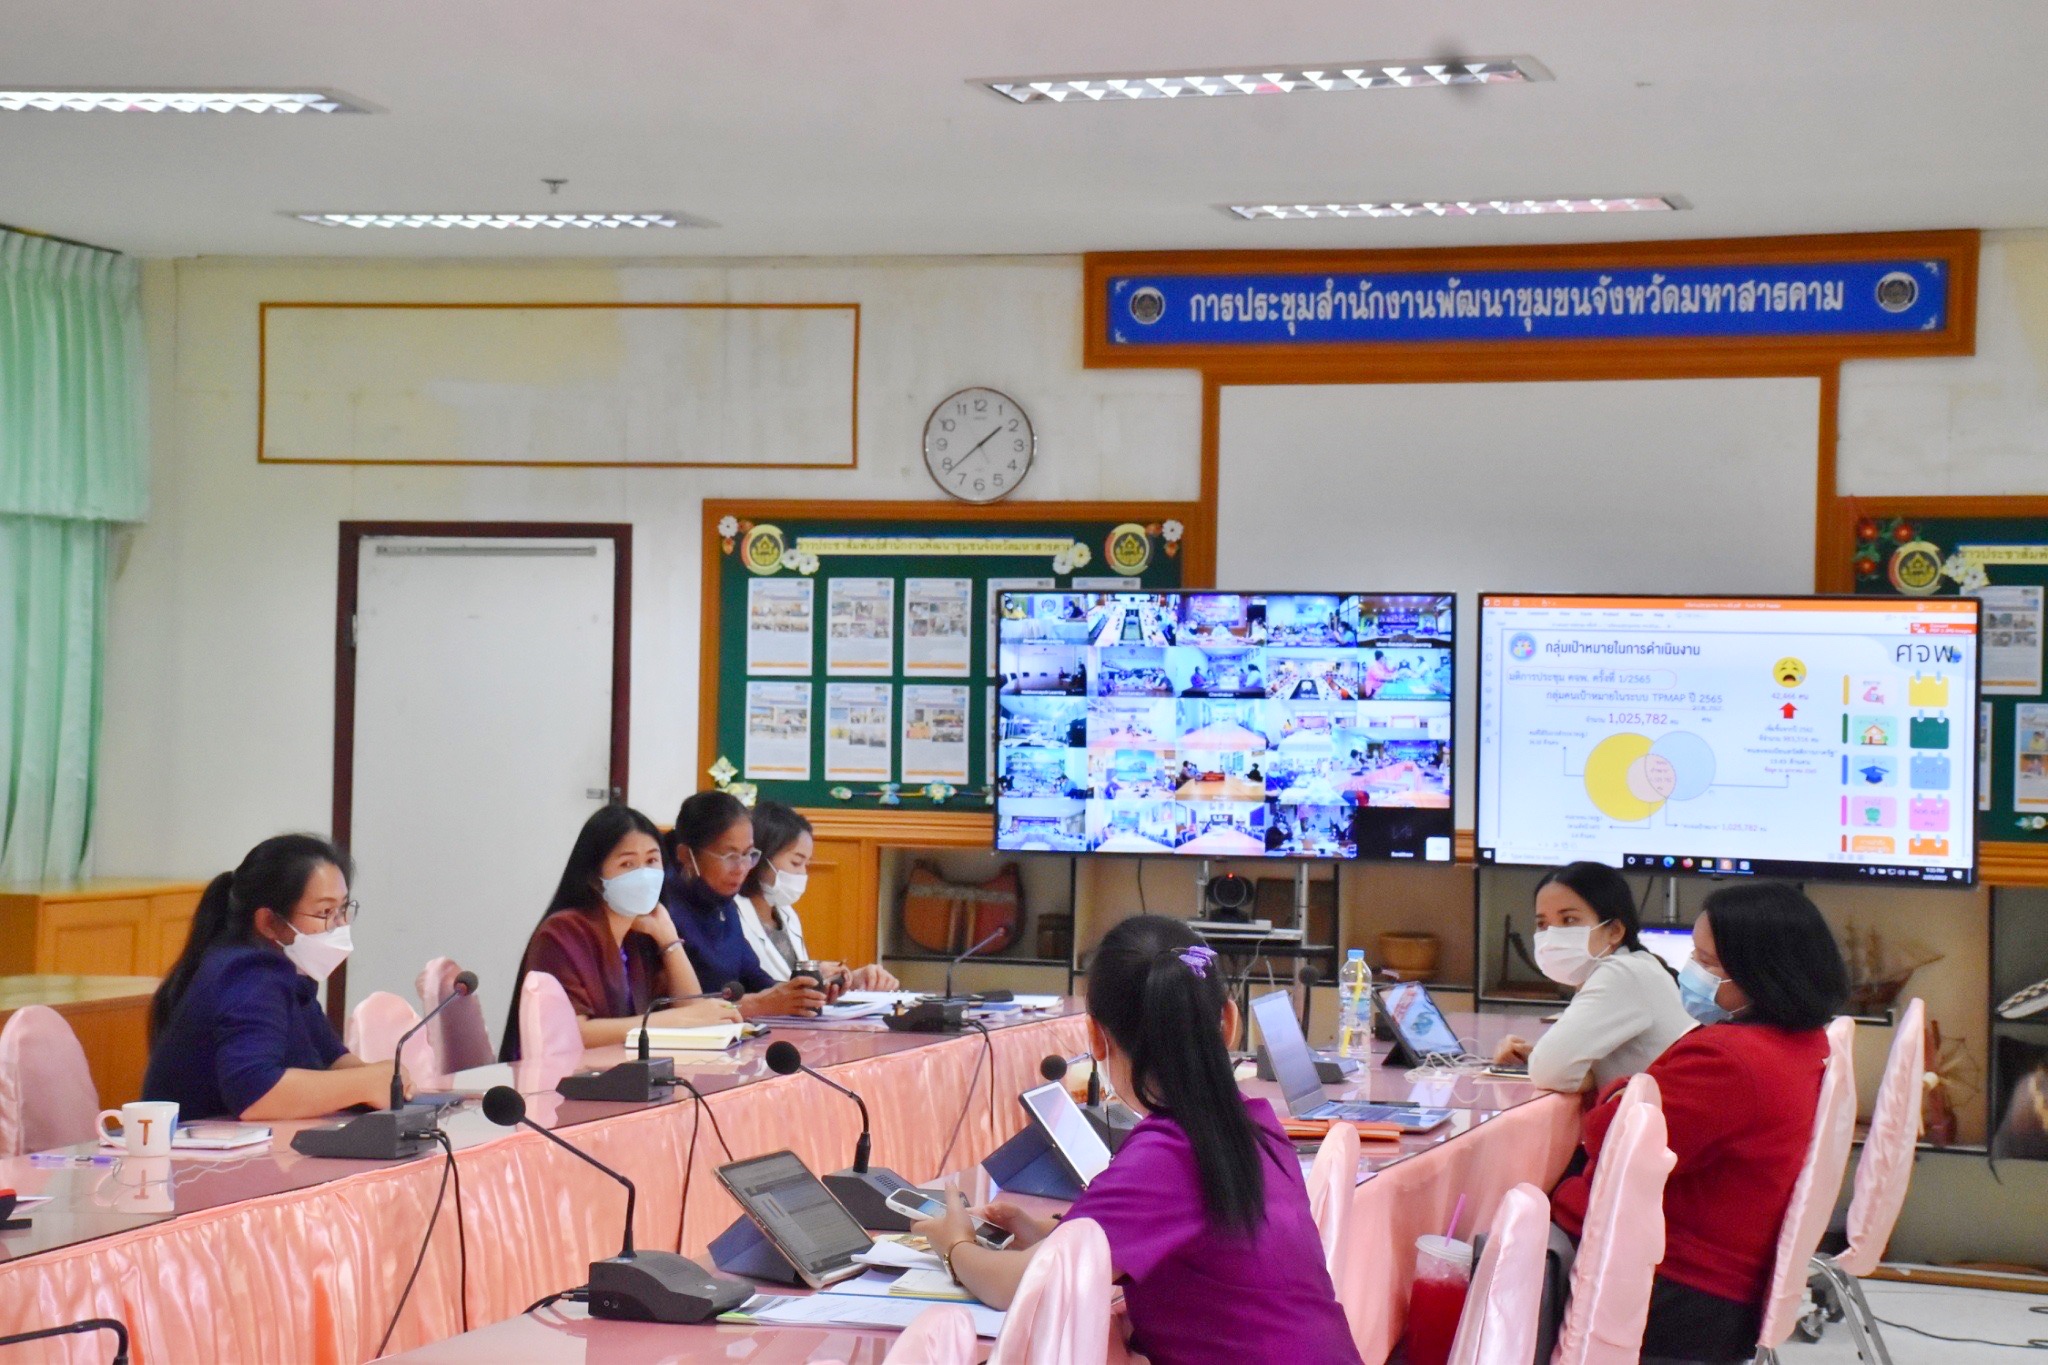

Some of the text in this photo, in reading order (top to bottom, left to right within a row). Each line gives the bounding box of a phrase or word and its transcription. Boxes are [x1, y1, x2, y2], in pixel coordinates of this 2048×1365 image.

[957, 404, 967, 415] 11
[974, 400, 988, 411] 12
[998, 404, 1003, 415] 1
[941, 419, 955, 432] 10
[1008, 419, 1019, 432] 2
[936, 438, 948, 451] 9
[1014, 439, 1024, 452] 3
[942, 457, 953, 470] 8
[1007, 459, 1017, 470] 4
[958, 473, 967, 485] 7
[973, 478, 985, 491] 6
[993, 473, 1004, 486] 5
[1545, 639, 1701, 659] กลุ่มเป้าหมายในการดำเนินงาน
[1619, 674, 1651, 684] 1/2565
[1608, 712, 1668, 725] 1,025,782
[137, 1119, 153, 1146] T
